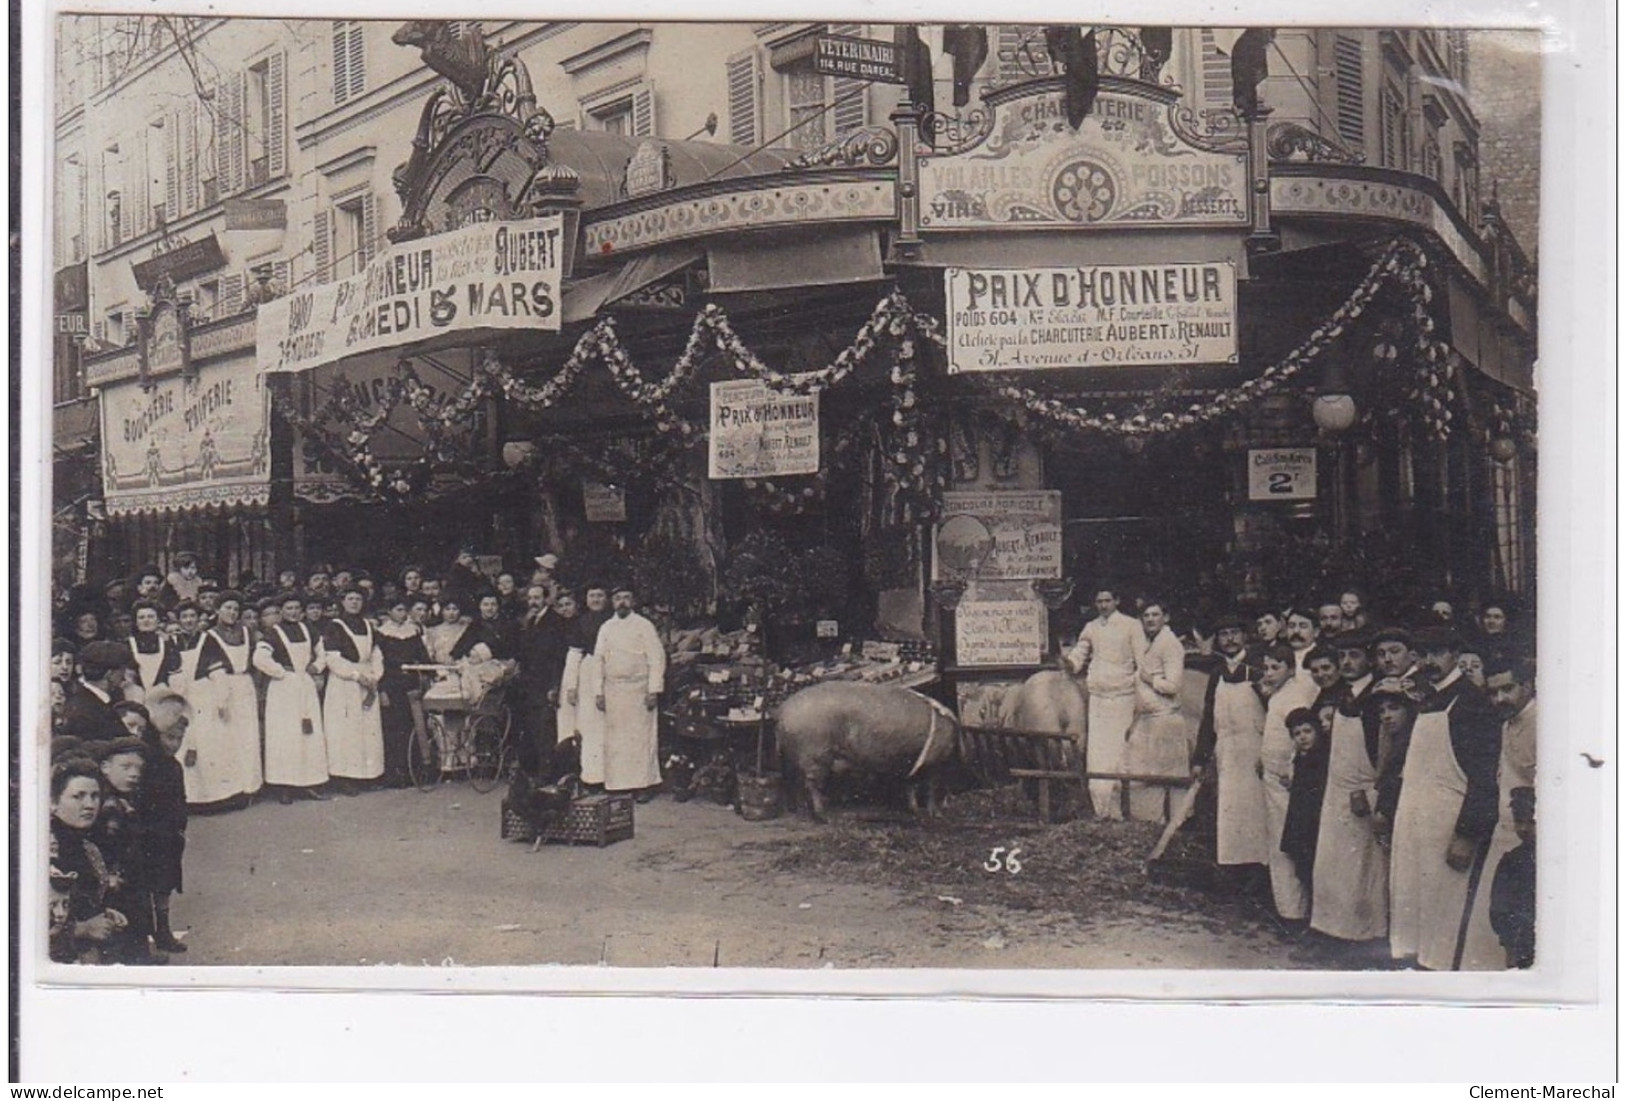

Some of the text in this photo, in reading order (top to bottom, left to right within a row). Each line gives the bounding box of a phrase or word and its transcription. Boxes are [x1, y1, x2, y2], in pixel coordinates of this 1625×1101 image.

[837, 60, 857, 73] RUE
[932, 164, 1232, 189] VOLAILLES POISSONS
[1183, 198, 1238, 215] DESSERTS
[493, 226, 560, 276] AUBERT
[966, 267, 1222, 311] PRIX D'HONNEUR
[345, 296, 421, 347] SAMEDI
[430, 284, 457, 326] 5
[468, 281, 554, 318] MARS
[956, 311, 986, 328] POIDS
[989, 310, 1017, 326] 604
[1030, 325, 1103, 345] CHARCUTERIE
[1106, 322, 1169, 341] AUBERT
[1177, 320, 1231, 345] RENAULT
[184, 379, 232, 432] TRIPERIE
[718, 405, 752, 428] PRIX
